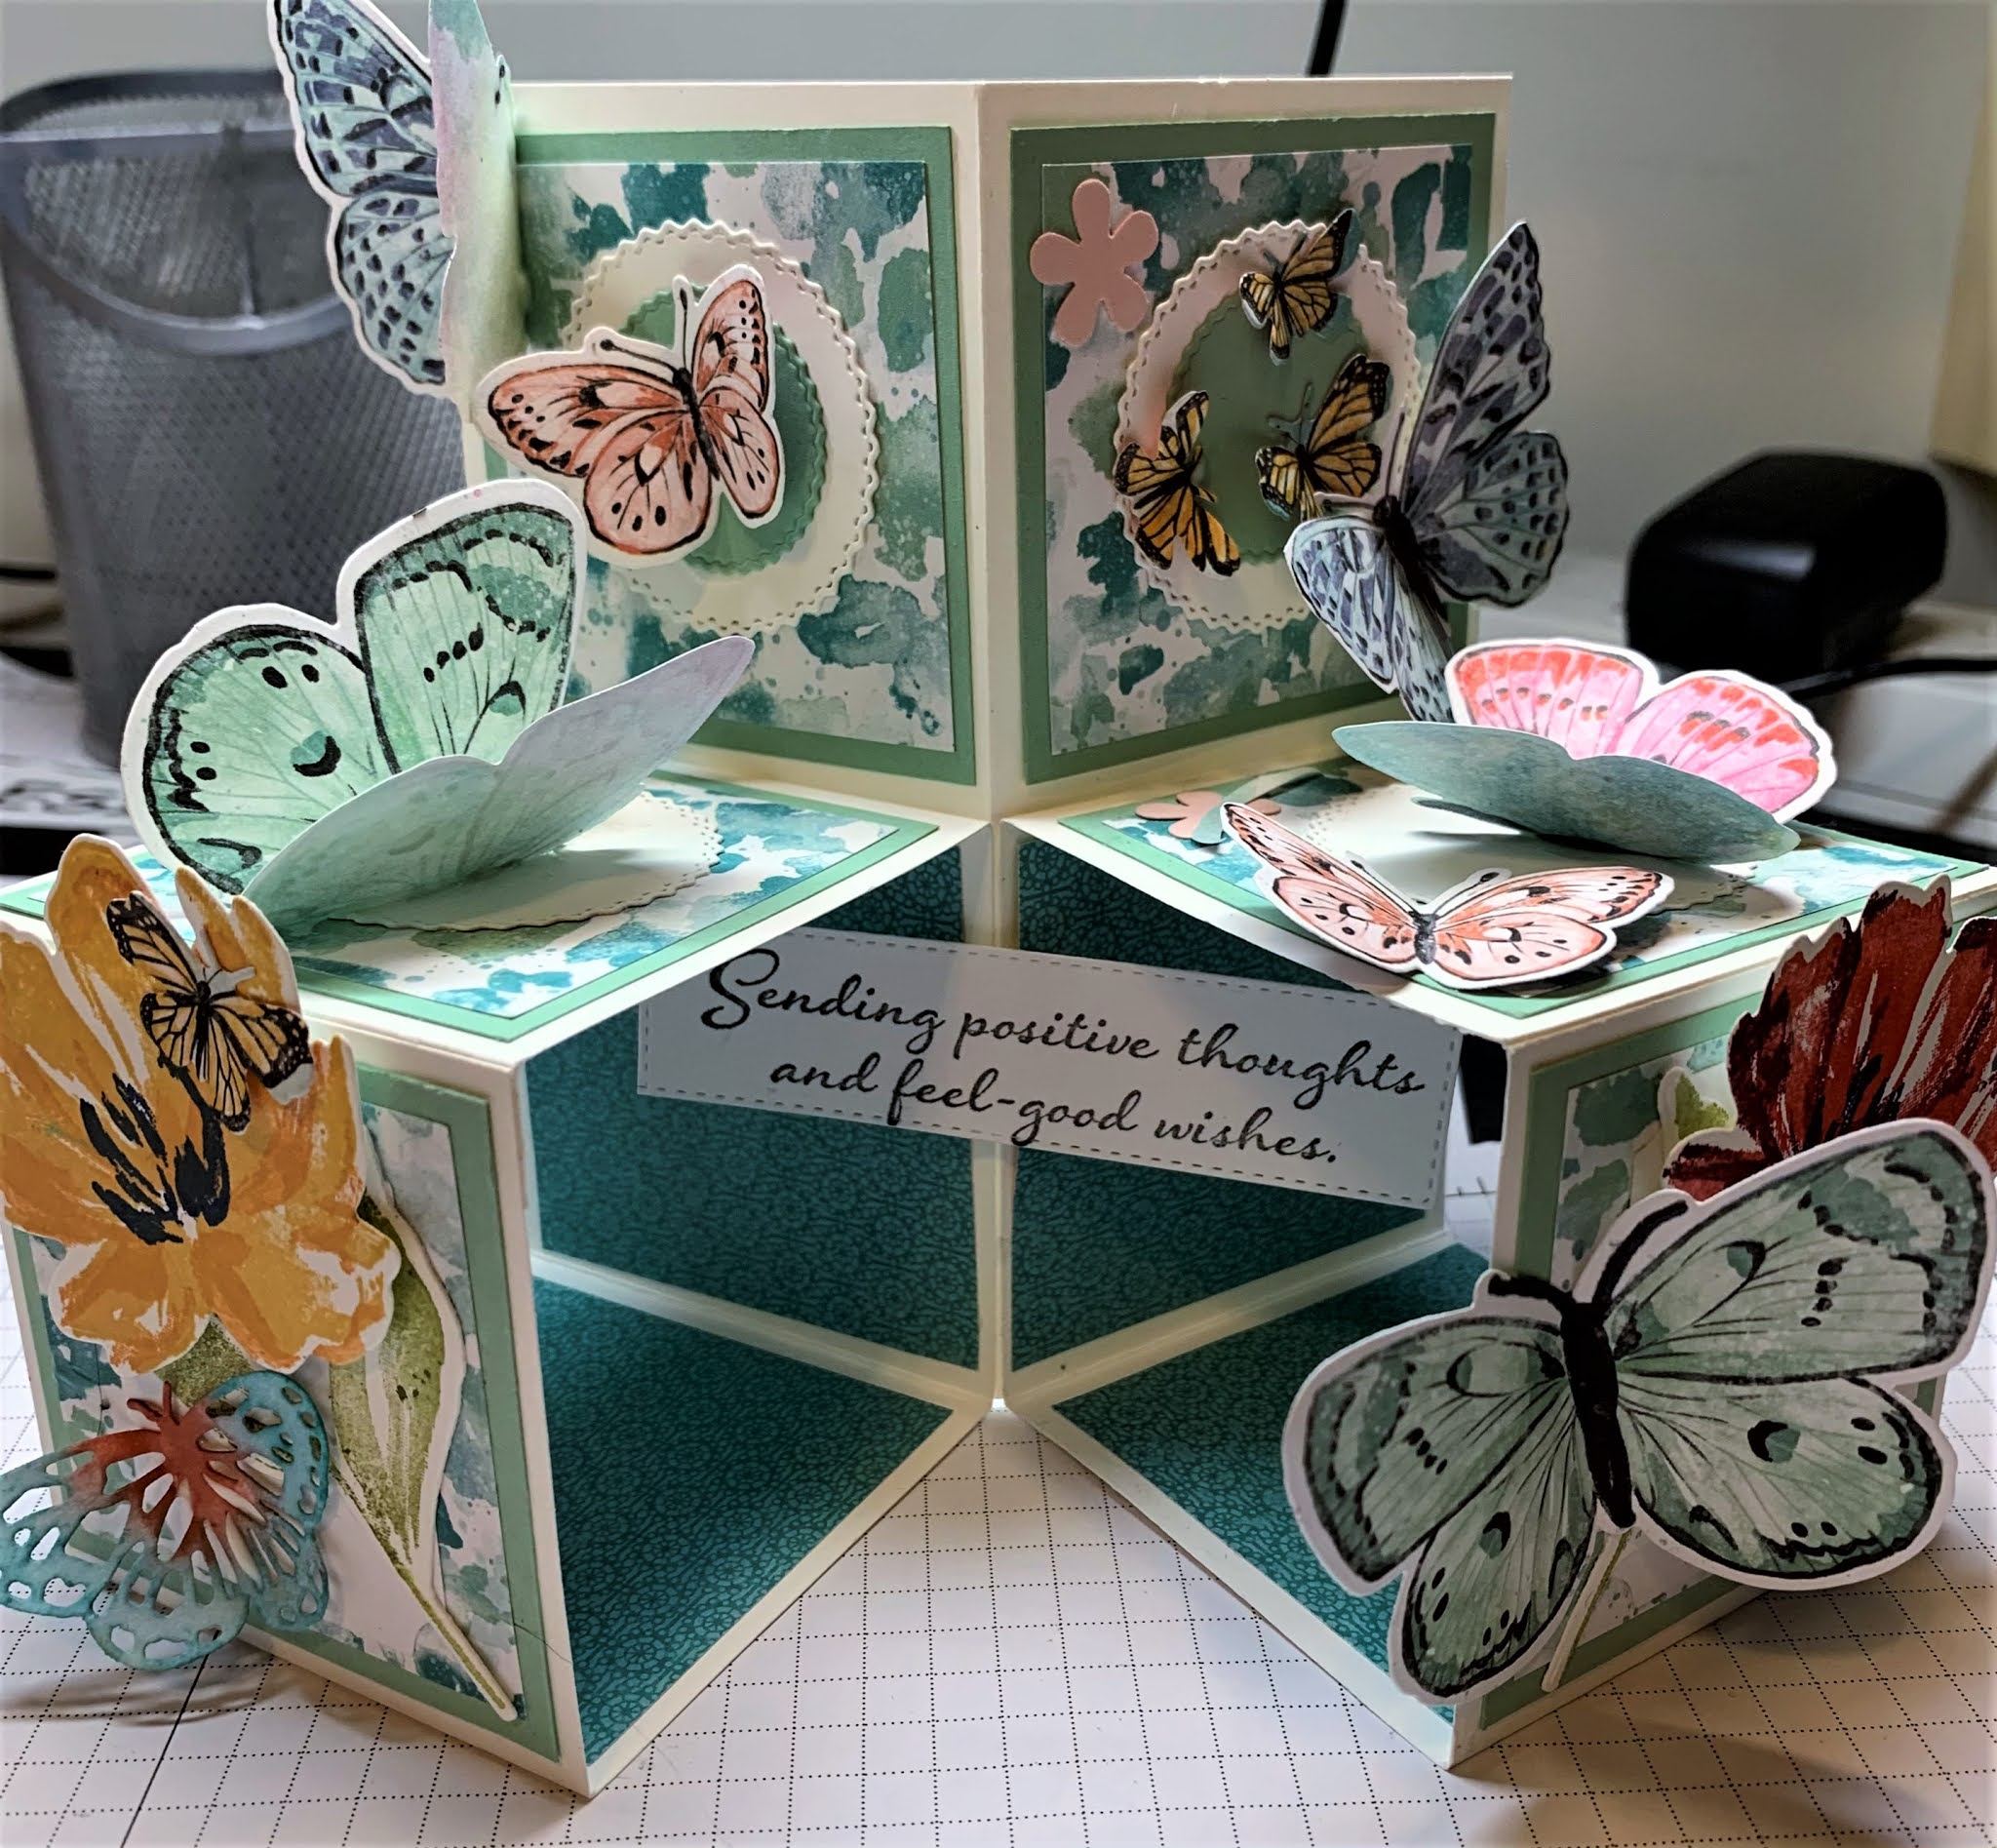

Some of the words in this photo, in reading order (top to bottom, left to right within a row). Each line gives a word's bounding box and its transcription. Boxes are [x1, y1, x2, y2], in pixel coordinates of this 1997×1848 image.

[701, 949, 947, 1054] Sending
[954, 1011, 1159, 1060] positive
[1178, 1023, 1426, 1110] thoughts
[770, 1052, 879, 1094] and
[886, 1057, 1140, 1147] feel-good
[1155, 1108, 1337, 1163] wishes.
